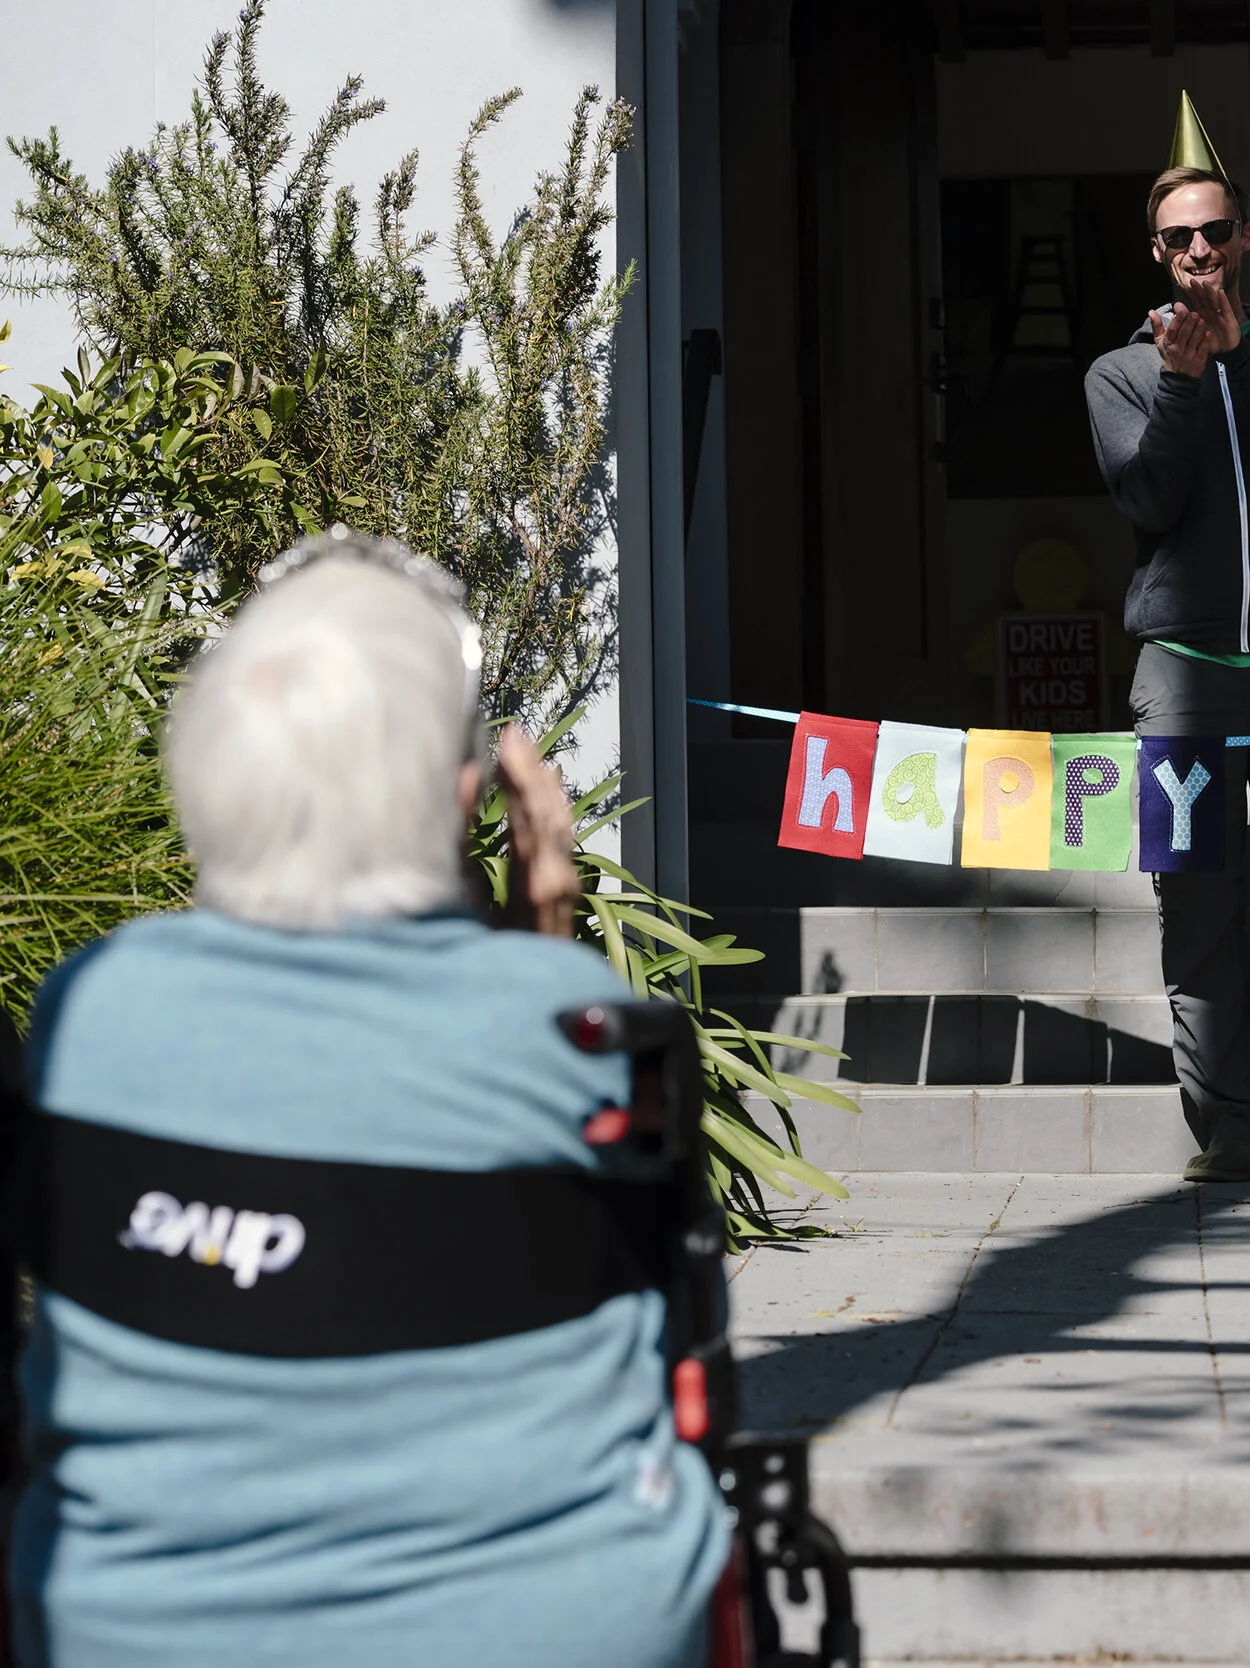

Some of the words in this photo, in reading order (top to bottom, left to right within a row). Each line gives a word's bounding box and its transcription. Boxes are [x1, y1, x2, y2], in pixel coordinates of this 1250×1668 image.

[1009, 623, 1095, 652] DRIVE
[1010, 656, 1045, 676] LIKE
[1048, 656, 1096, 676] YOUR
[1019, 680, 1087, 705] KIDS
[1012, 711, 1046, 730] LIVE
[1052, 710, 1096, 730] HERE
